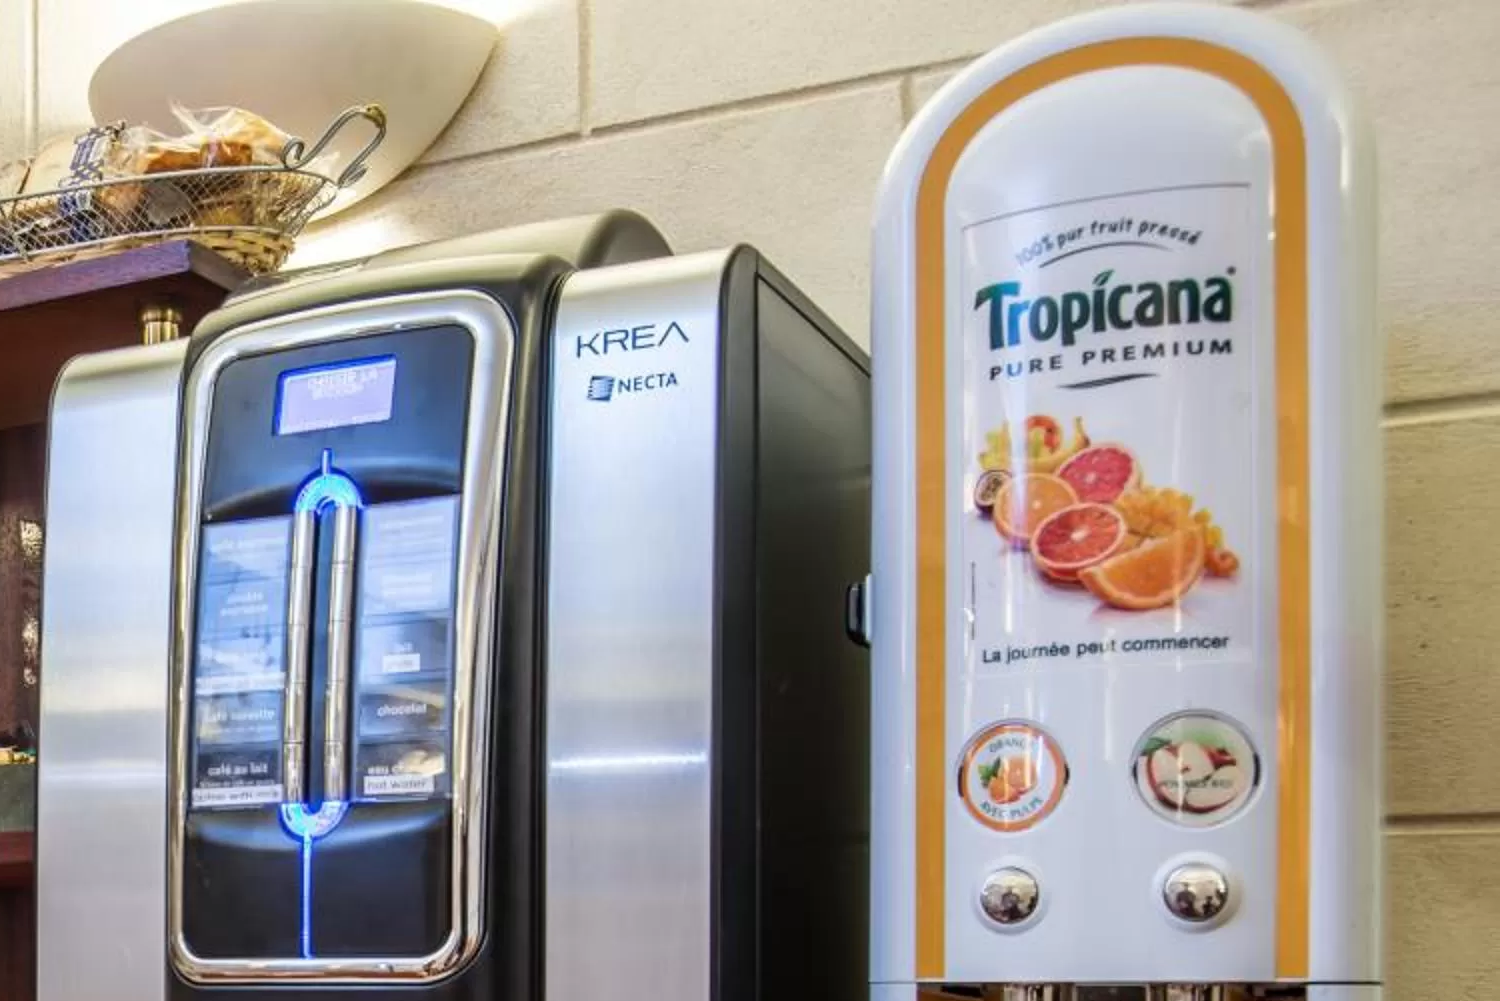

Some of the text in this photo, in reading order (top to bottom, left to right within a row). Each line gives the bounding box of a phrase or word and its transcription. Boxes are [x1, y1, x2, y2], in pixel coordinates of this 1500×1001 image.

[1015, 217, 1203, 266] 100% pur fruit pressé
[974, 268, 1235, 351] Tropicana
[576, 321, 690, 359] KREA
[989, 338, 1234, 381] PURE PREMIUM
[617, 371, 679, 395] NECTA
[982, 635, 1230, 665] La journée peut commencer
[377, 703, 428, 717] chocolat
[989, 737, 1039, 753] ORANG
[250, 761, 269, 774] lait
